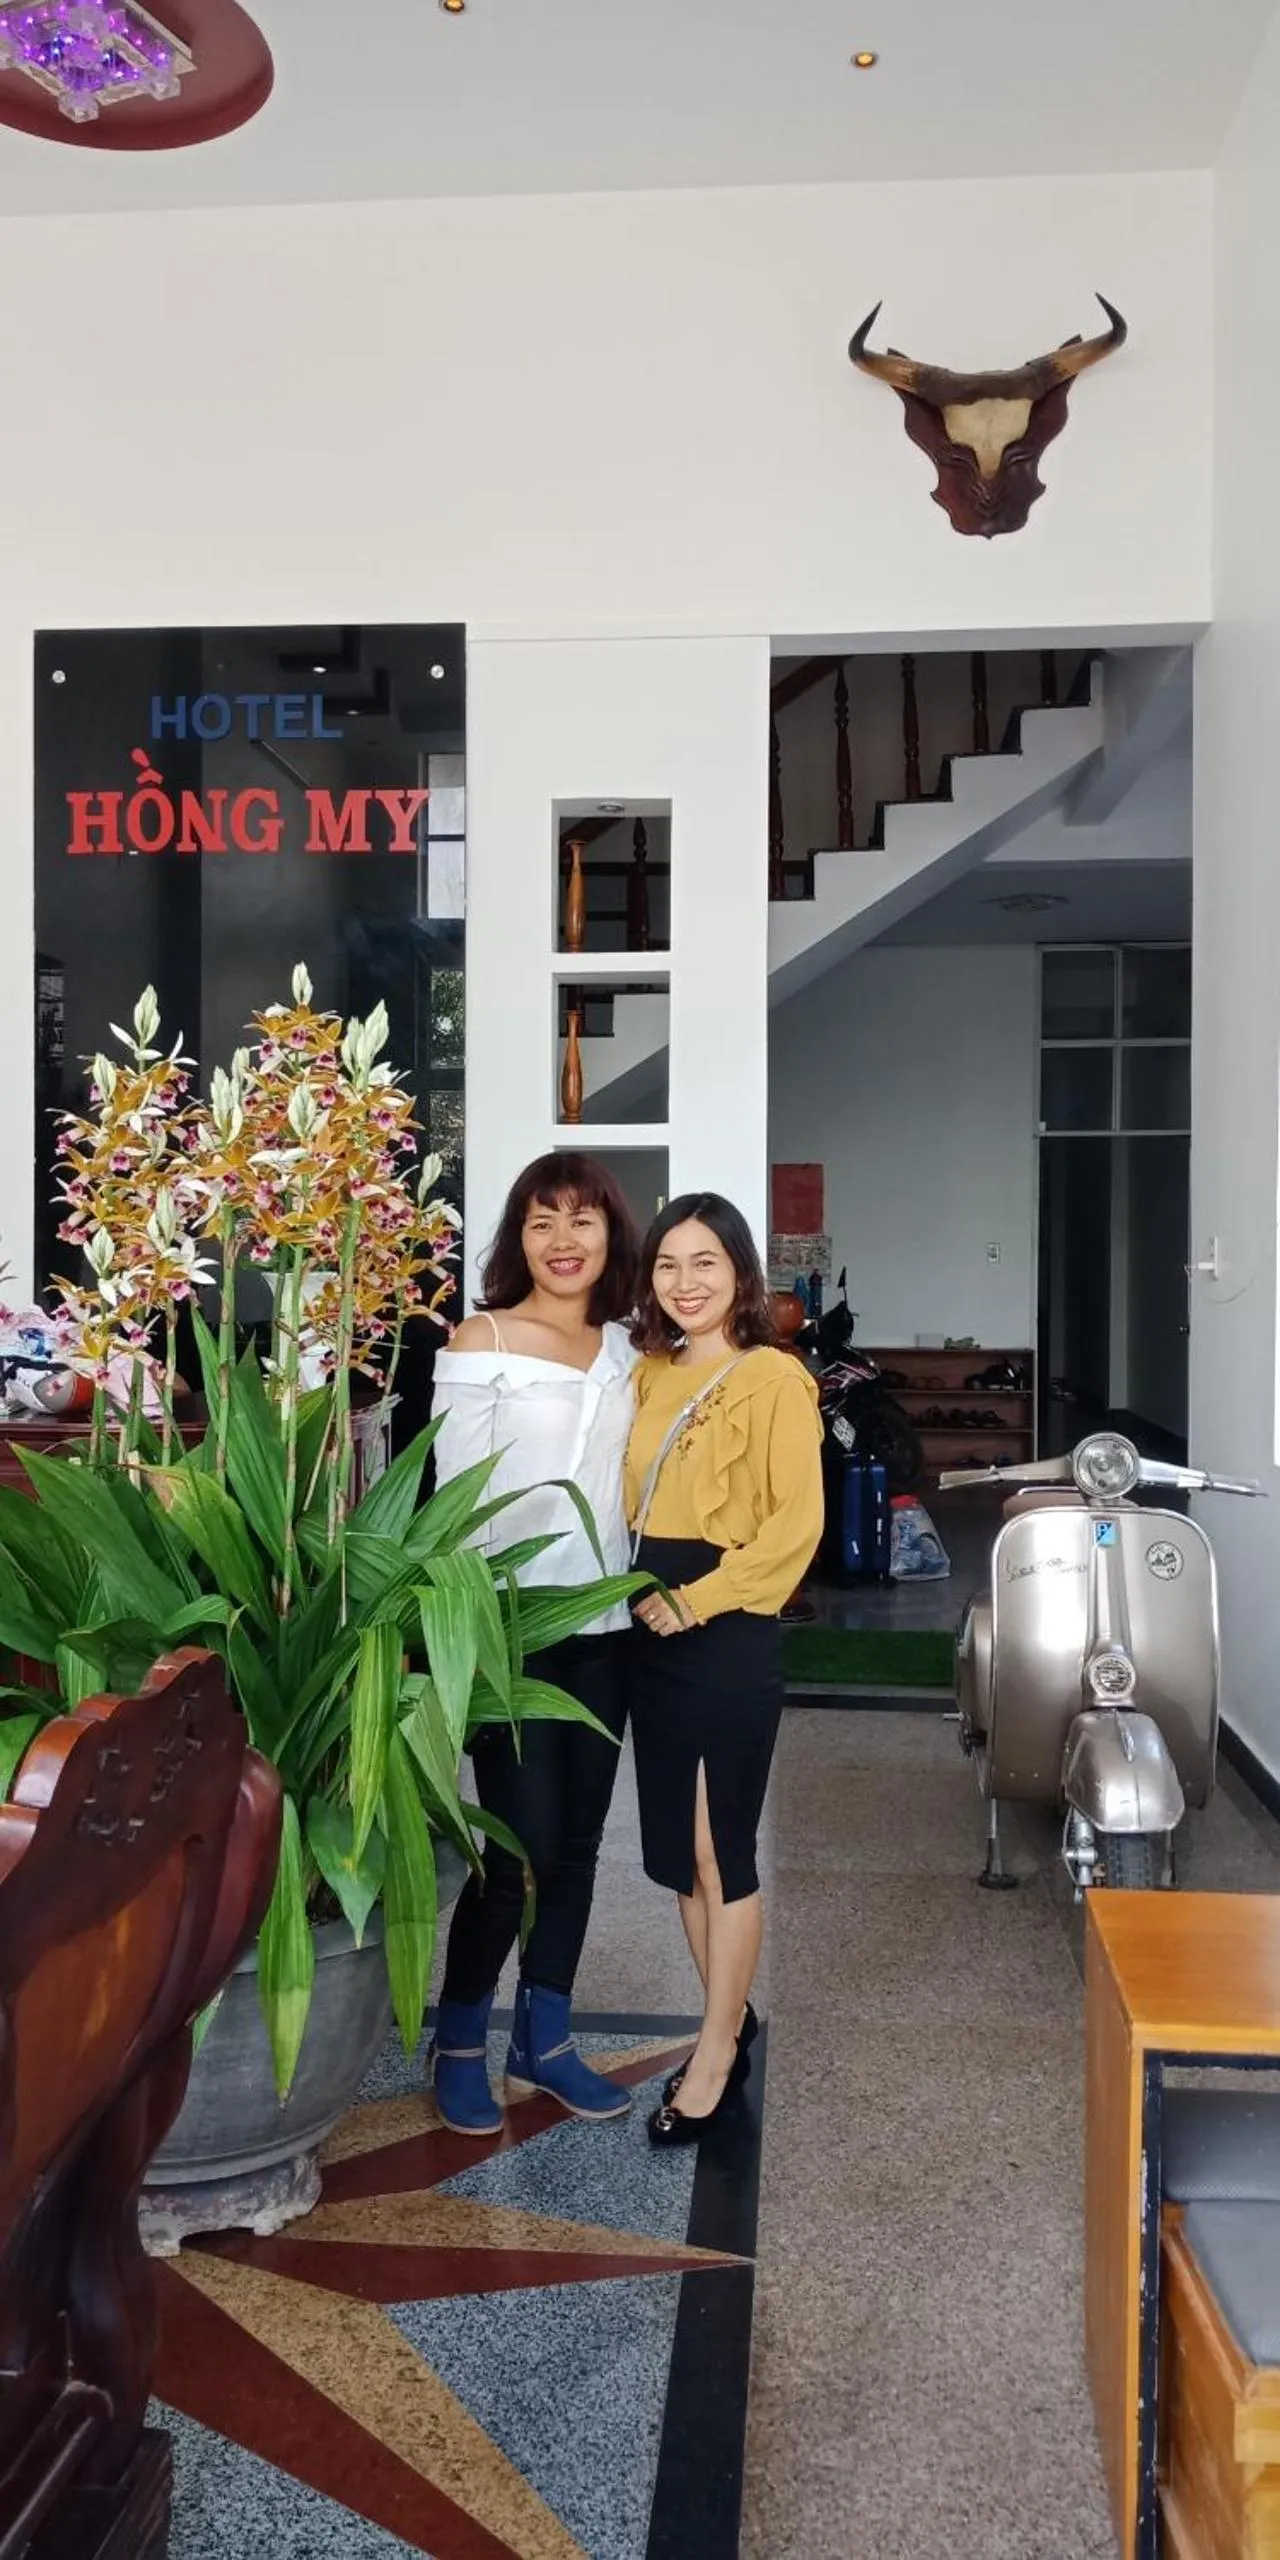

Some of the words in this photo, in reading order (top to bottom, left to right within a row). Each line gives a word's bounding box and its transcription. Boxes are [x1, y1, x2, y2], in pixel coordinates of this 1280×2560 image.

[151, 694, 343, 740] HOTEL
[67, 748, 284, 855] HỒNG
[306, 789, 430, 853] MY
